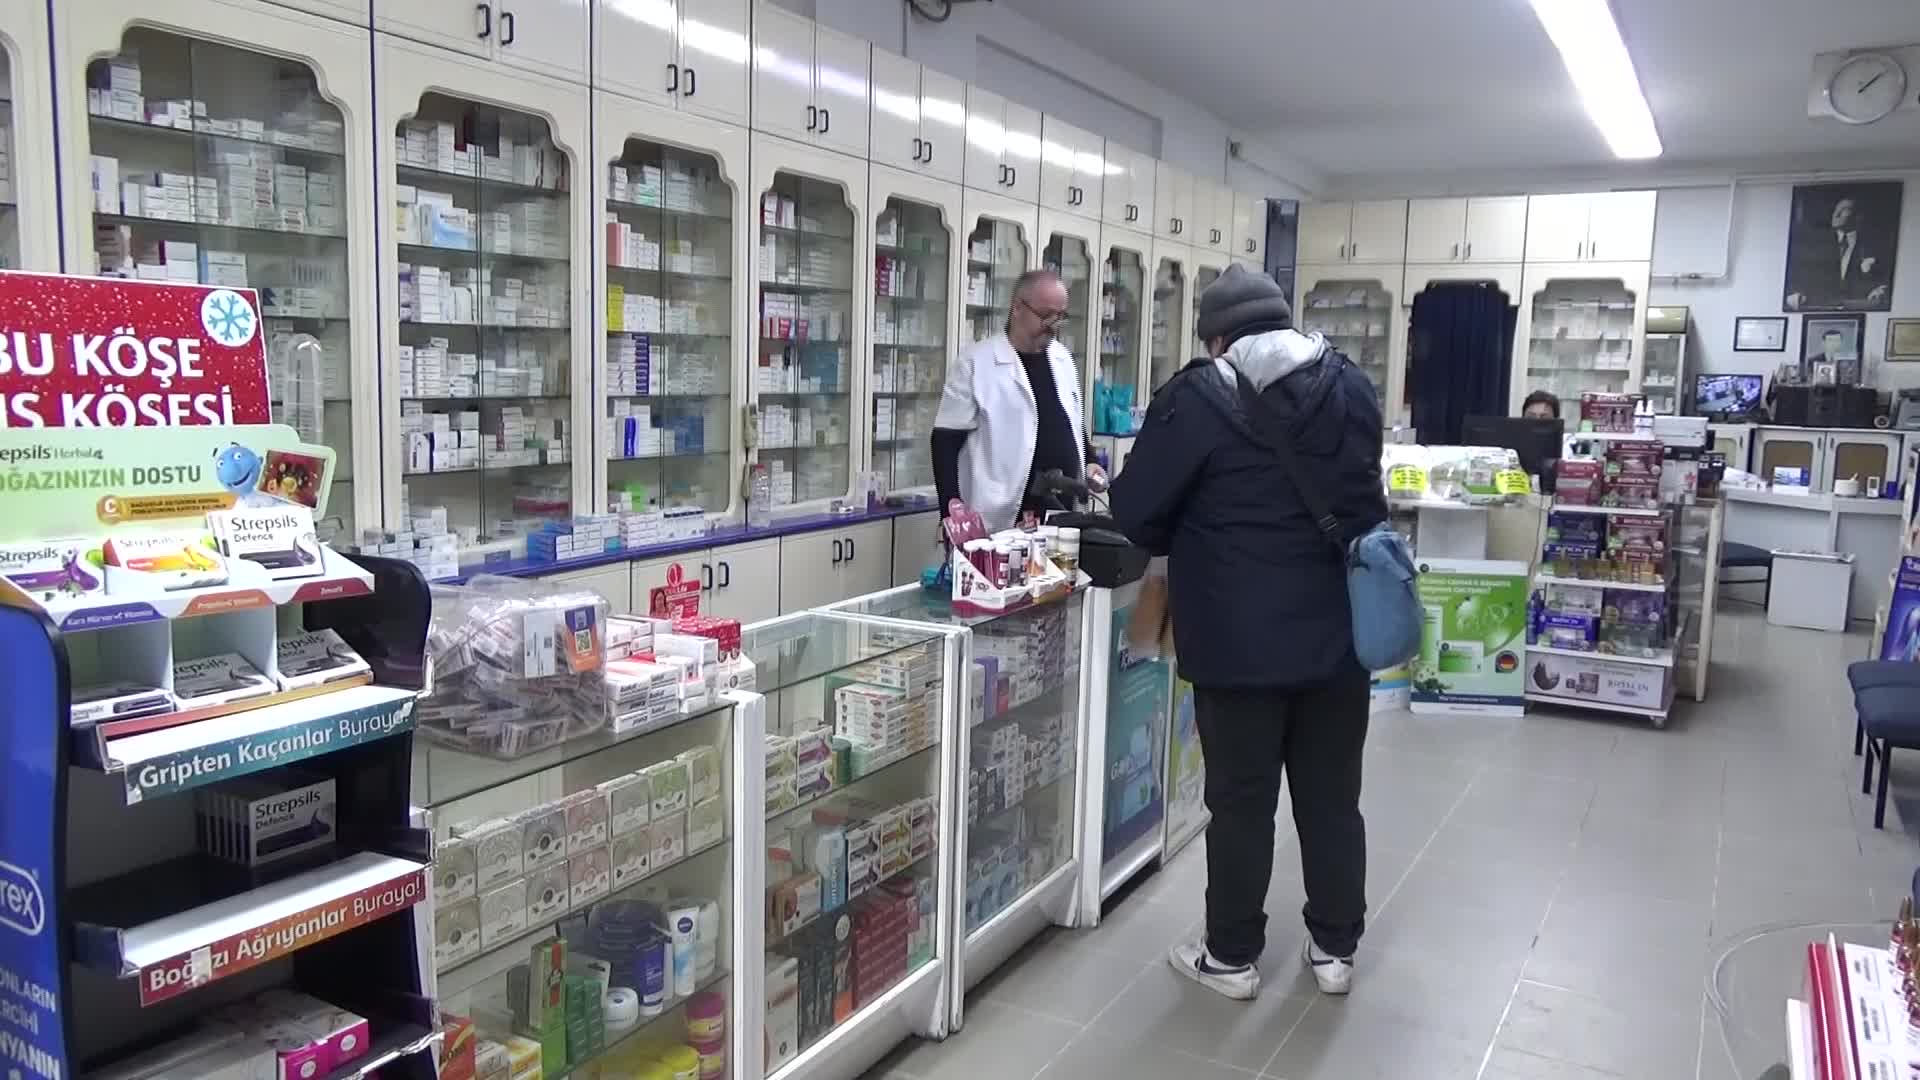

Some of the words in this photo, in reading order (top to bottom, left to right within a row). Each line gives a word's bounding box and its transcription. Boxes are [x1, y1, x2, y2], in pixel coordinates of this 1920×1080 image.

[72, 326, 204, 388] KÖŞE
[132, 464, 201, 486] DOSTU
[230, 514, 299, 533] Strepsils
[233, 532, 274, 544] Defence
[0, 546, 59, 564] Strepsils
[138, 752, 232, 788] Gripten
[237, 725, 333, 763] Kaçanlar
[339, 704, 410, 738] Buraya
[255, 789, 322, 819] Strepsils
[255, 813, 296, 829] Defence
[150, 949, 230, 992] Boğzı
[236, 906, 348, 961] Ağrıyanlar
[353, 875, 421, 918] Buraya!
